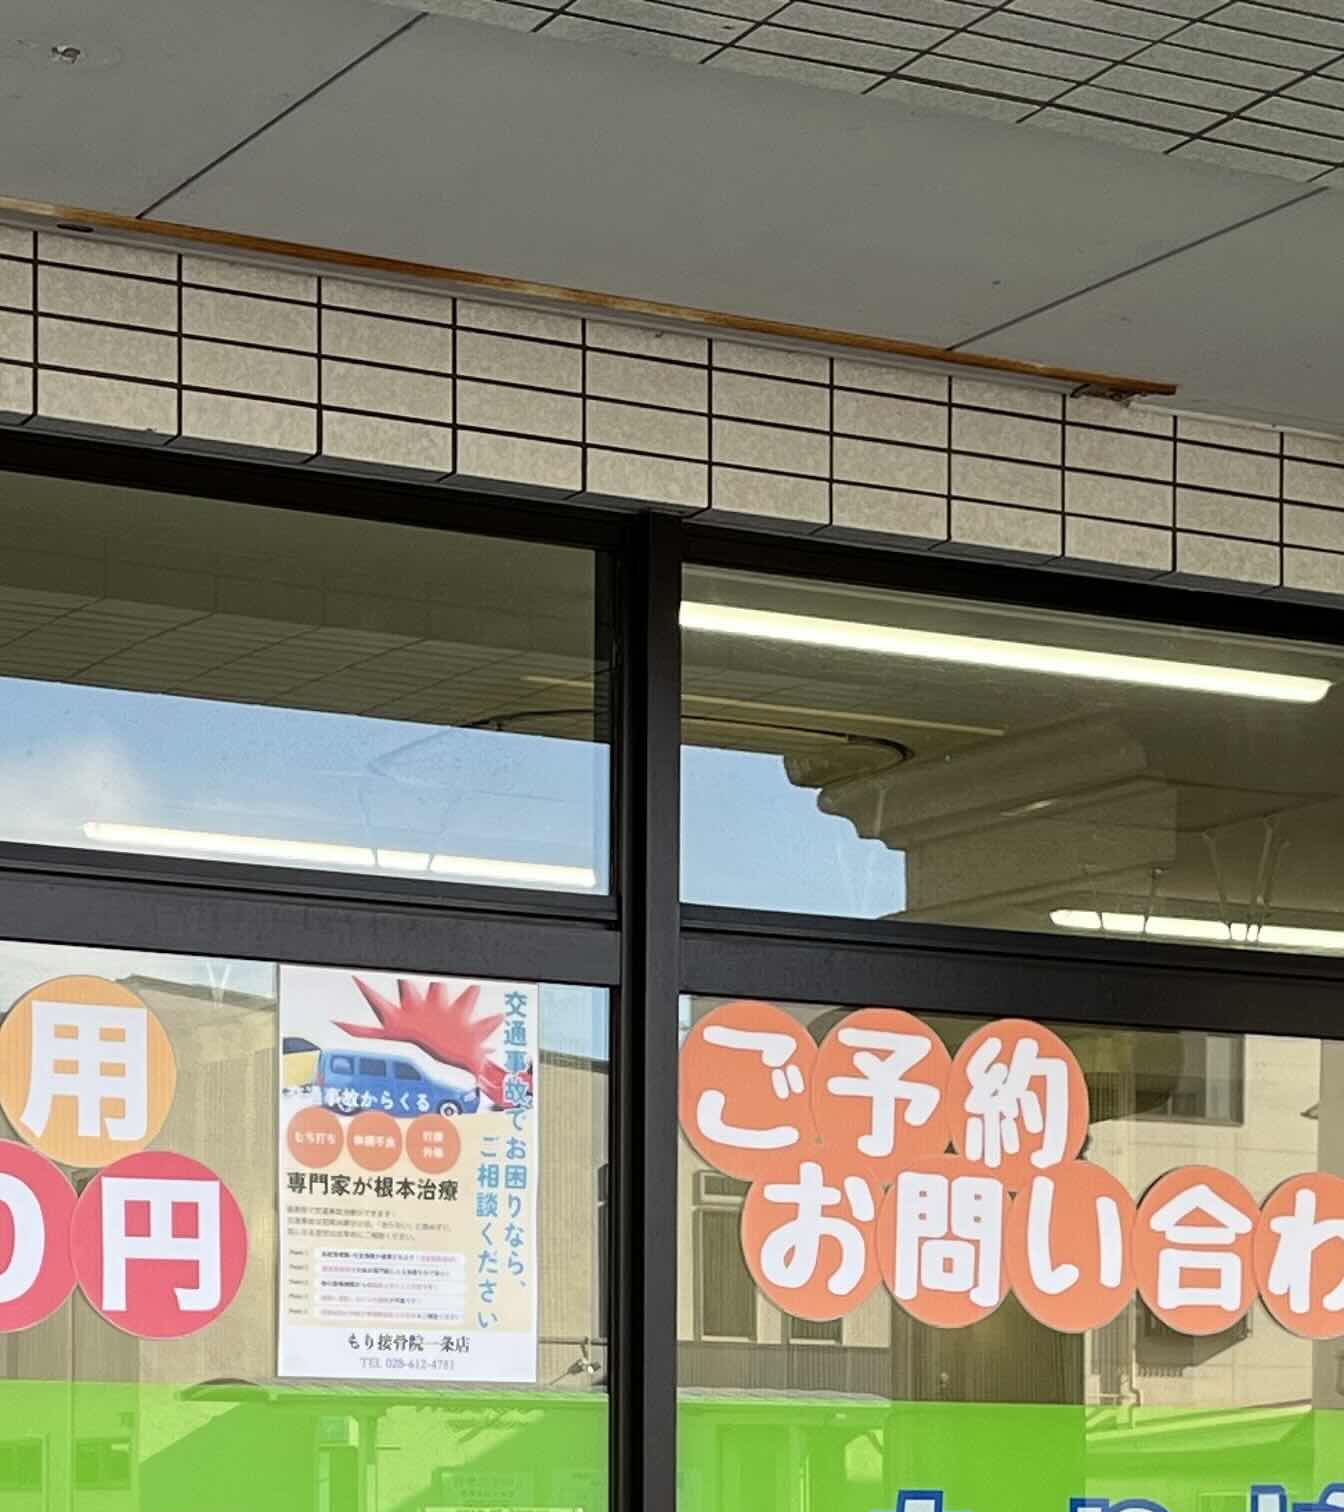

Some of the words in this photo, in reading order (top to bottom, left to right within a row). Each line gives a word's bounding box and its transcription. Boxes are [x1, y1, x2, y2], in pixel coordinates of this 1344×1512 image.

[694, 1023, 1071, 1169] ご予約
[287, 1171, 459, 1201] 専門家が根本治療
[475, 1135, 500, 1329] ご相談ください
